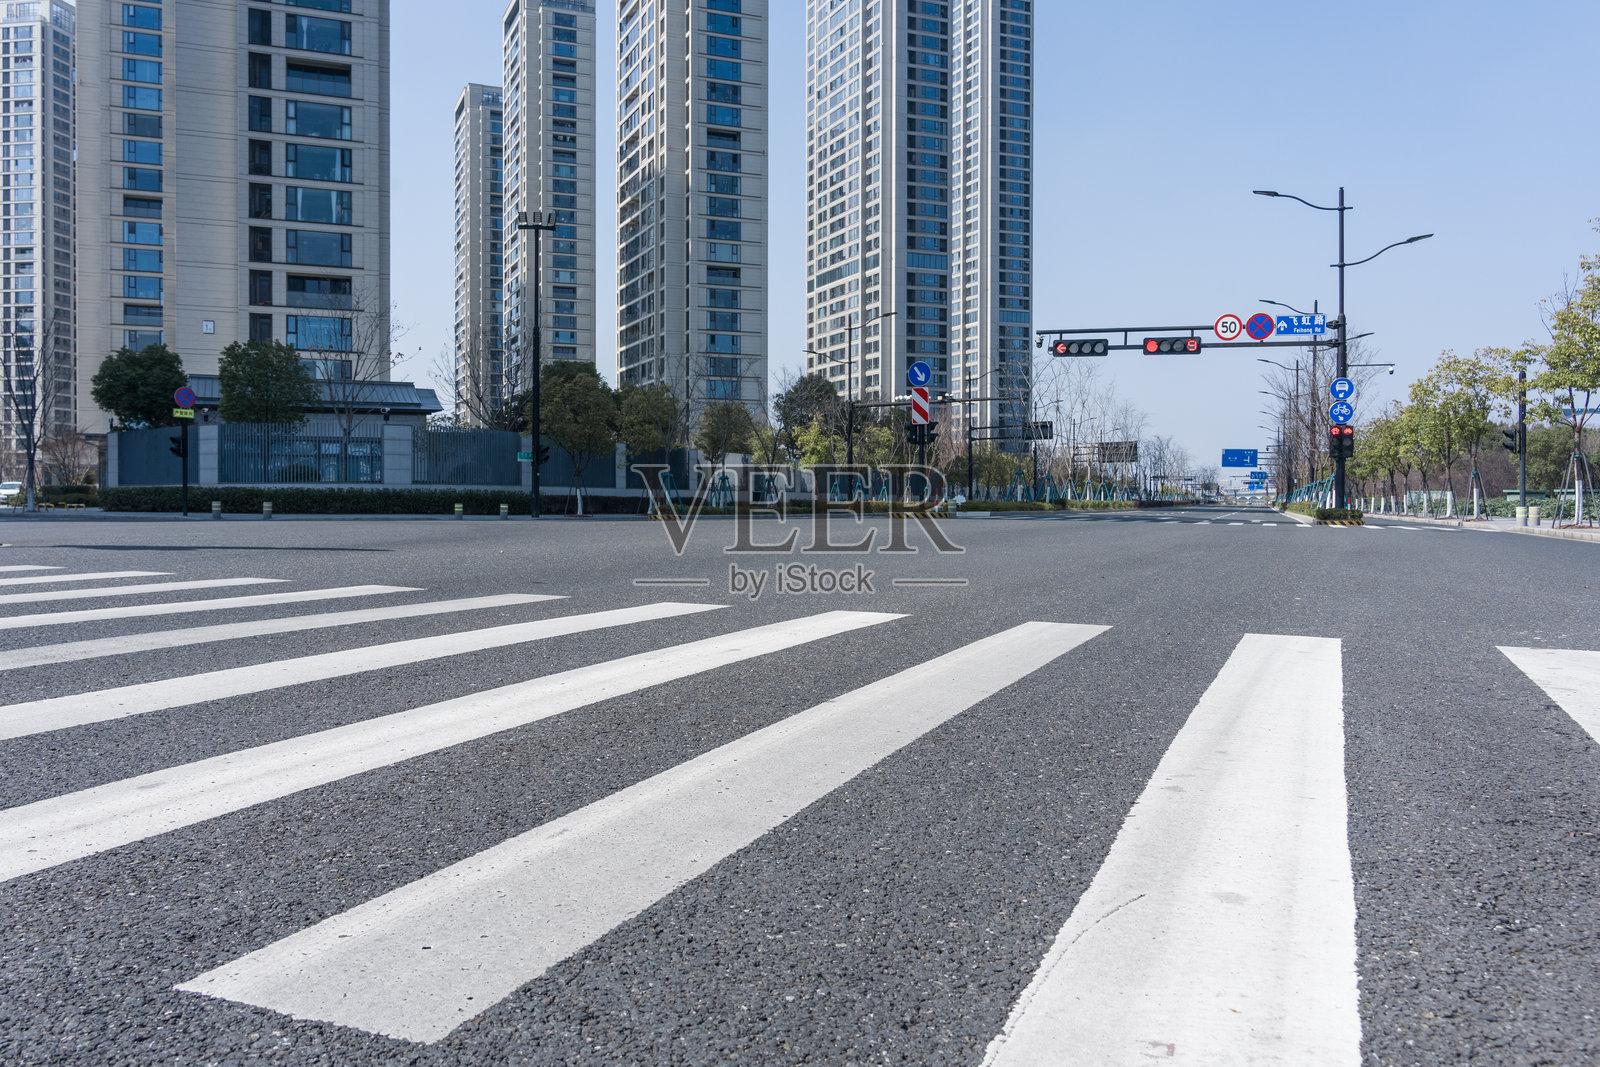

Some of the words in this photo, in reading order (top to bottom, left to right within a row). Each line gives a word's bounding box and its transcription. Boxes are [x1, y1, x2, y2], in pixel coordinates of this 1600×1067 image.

[1289, 315, 1324, 325] 飞虹路
[1221, 321, 1237, 333] 50
[1187, 339, 1197, 351] 9
